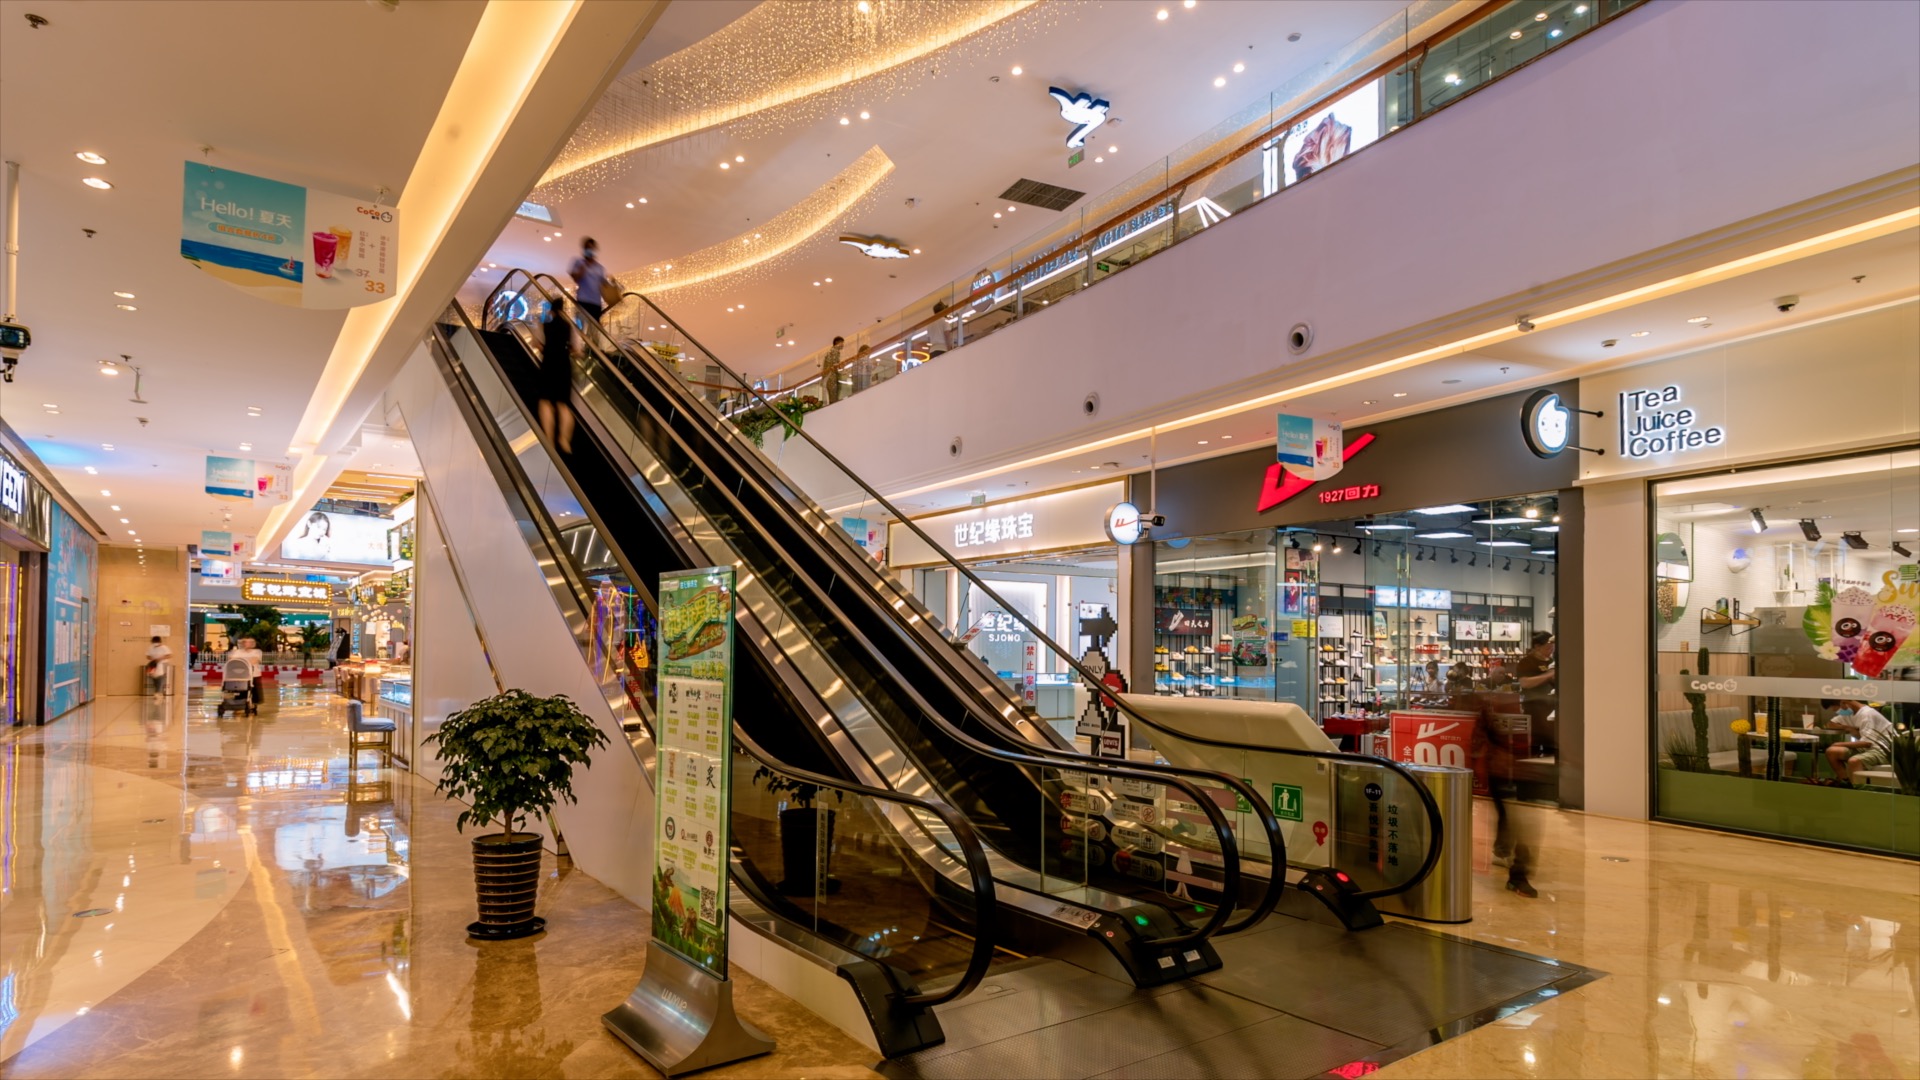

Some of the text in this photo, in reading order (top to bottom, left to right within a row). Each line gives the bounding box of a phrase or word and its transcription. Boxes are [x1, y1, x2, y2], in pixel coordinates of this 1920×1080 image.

[201, 197, 292, 229] Hello! 夏天
[356, 206, 380, 217] CoCo
[365, 280, 386, 294] 33
[1628, 385, 1678, 411] Tea
[1628, 408, 1693, 437] Juice
[1628, 426, 1723, 458] Coffee
[1318, 484, 1379, 503] 1927回力
[954, 511, 1034, 548] 世纪缘珠宝
[1691, 680, 1723, 692] CoCo
[1821, 684, 1861, 697] CoCo
[1365, 788, 1381, 796] 1F-11
[1387, 804, 1399, 867] 垃圾不落地
